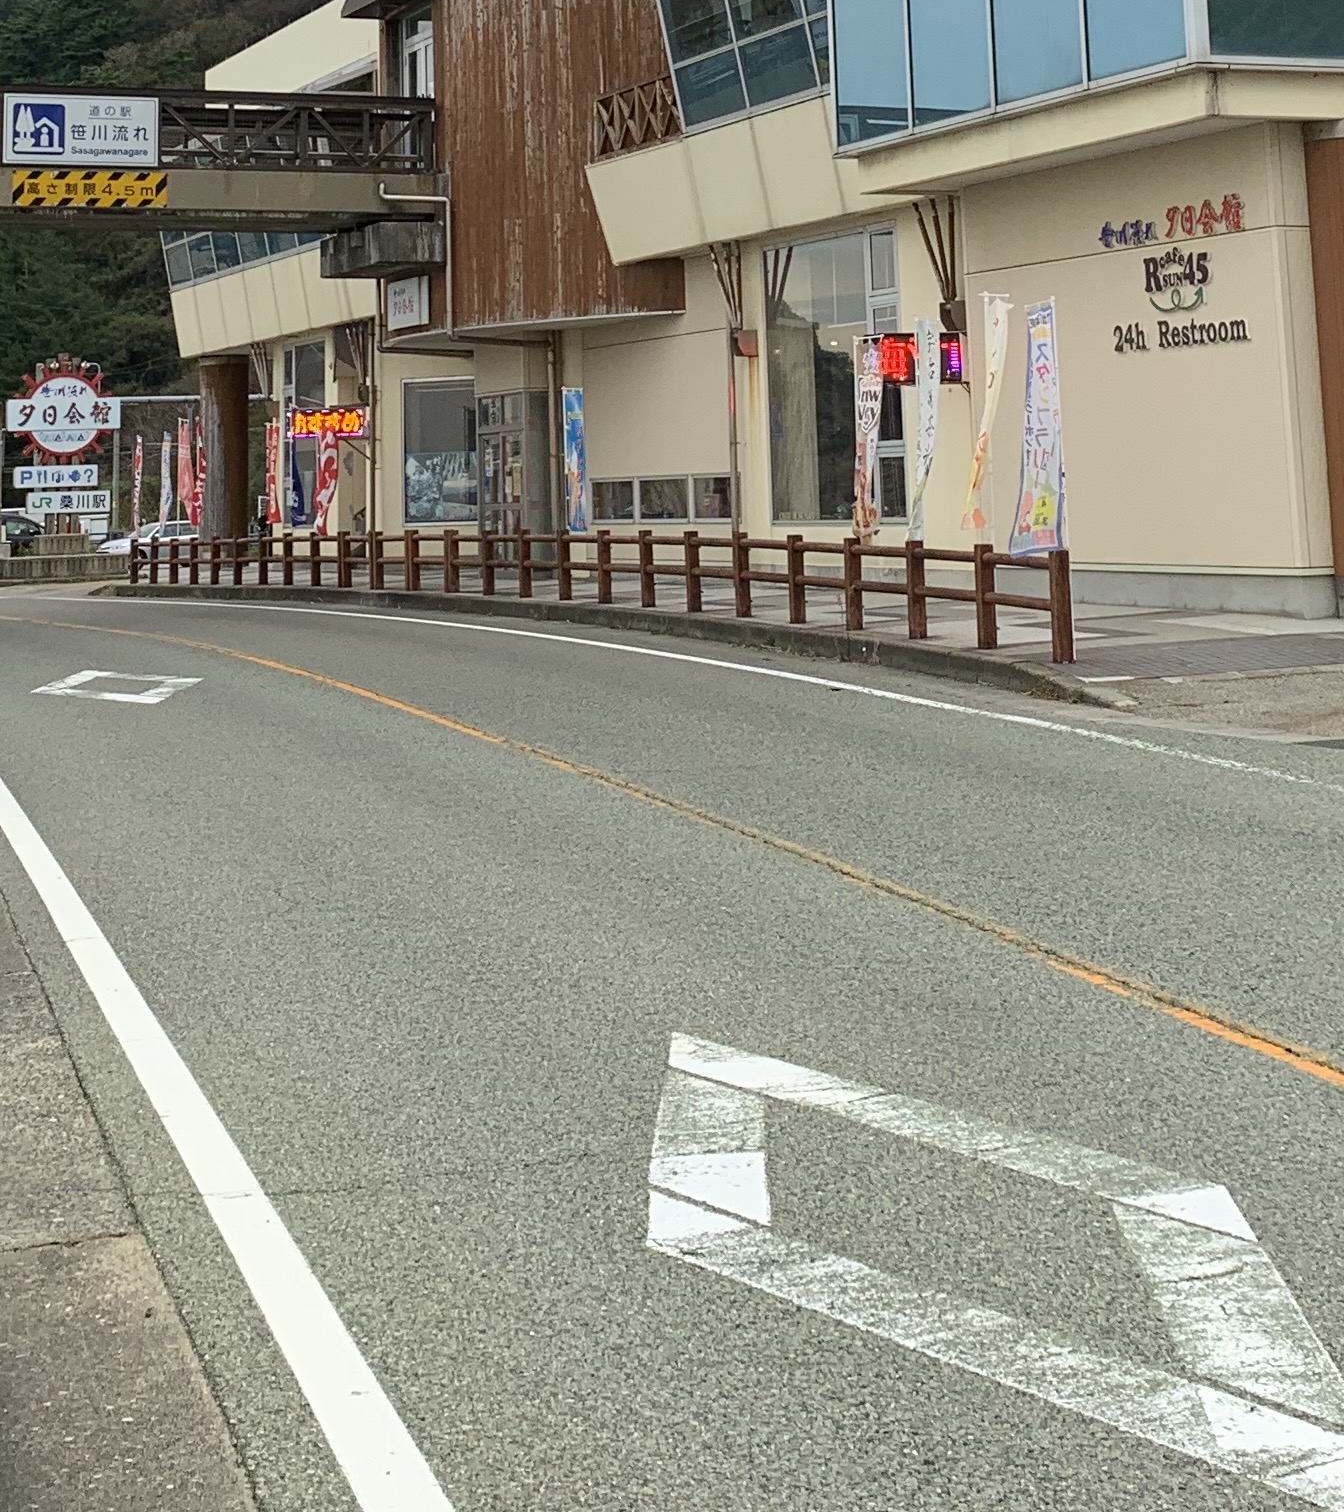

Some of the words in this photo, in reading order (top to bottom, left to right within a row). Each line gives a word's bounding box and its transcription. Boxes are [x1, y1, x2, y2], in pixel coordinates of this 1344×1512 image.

[89, 105, 132, 117] 道の駅
[70, 124, 149, 142] 笹川流れ
[71, 146, 149, 158] Sasagawanagare
[1164, 193, 1244, 239] 夕日会館
[1114, 322, 1147, 352] 24h
[1157, 319, 1248, 348] Restroom
[18, 401, 112, 426] 夕日会館
[32, 498, 52, 508] JR
[60, 495, 106, 509] 桑川駅
